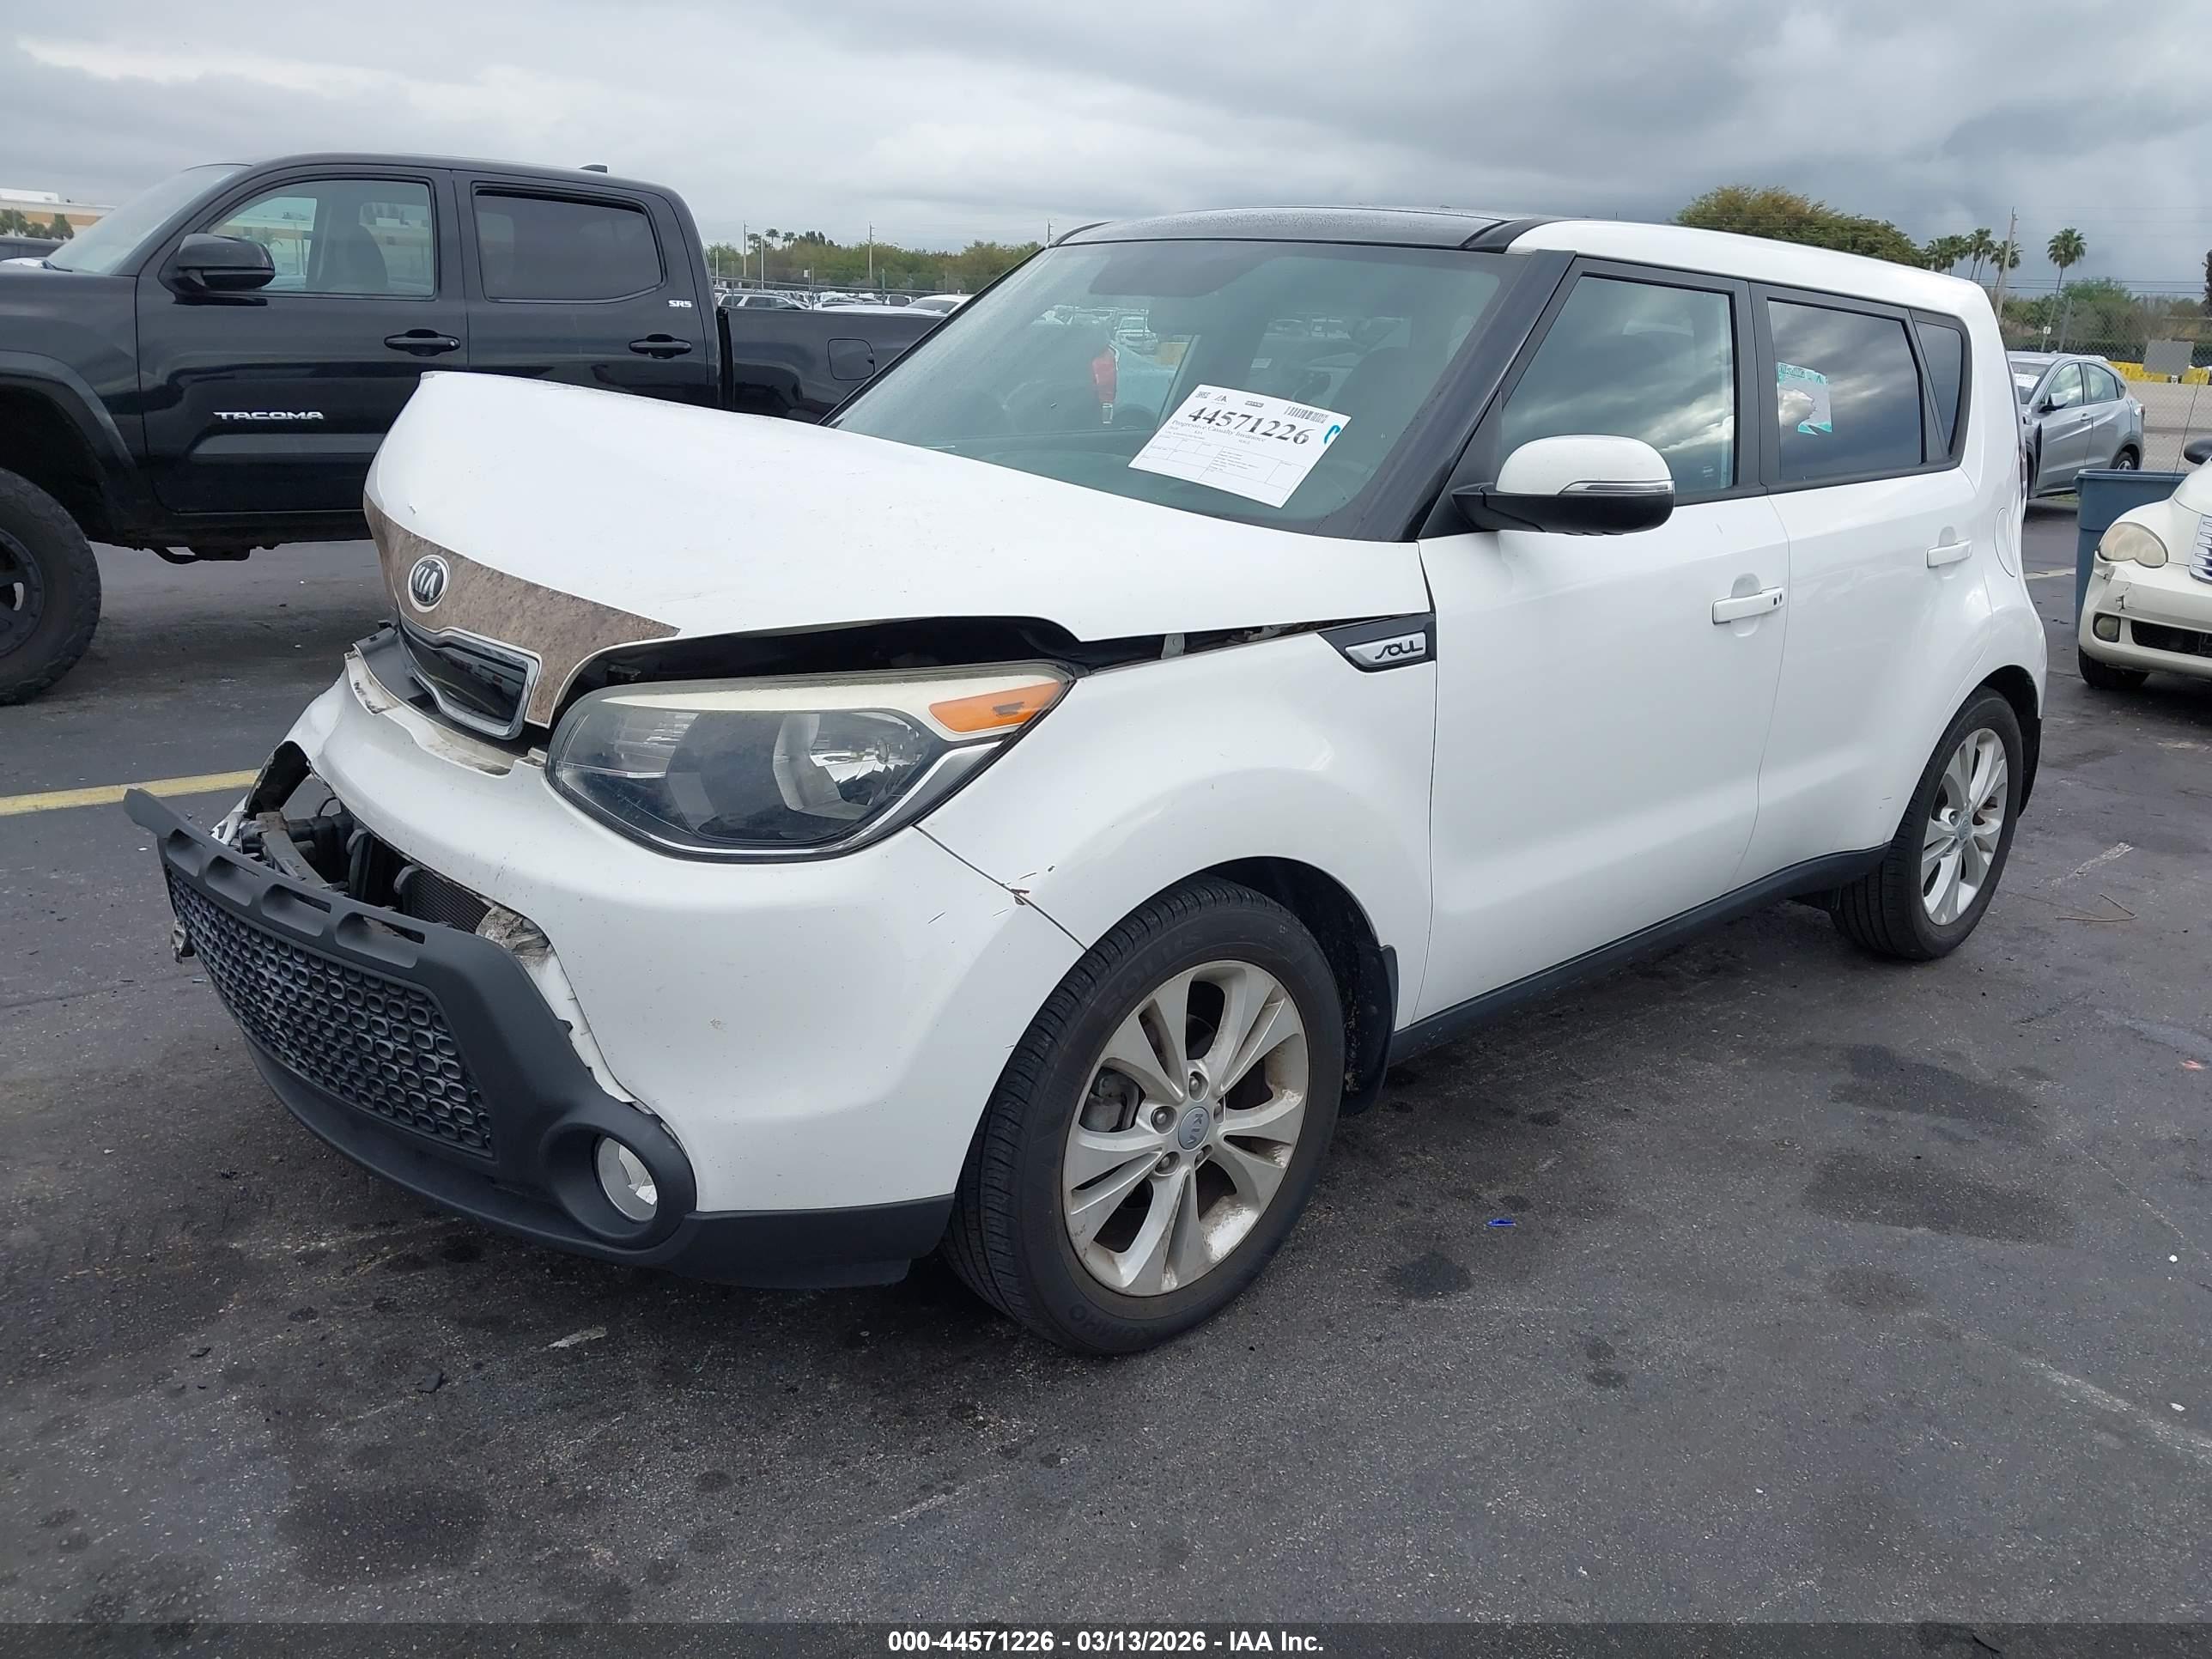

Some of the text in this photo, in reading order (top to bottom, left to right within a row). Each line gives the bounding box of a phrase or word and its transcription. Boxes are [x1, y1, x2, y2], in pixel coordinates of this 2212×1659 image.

[213, 411, 324, 420] TACOMA
[1188, 406, 1316, 446] 44571226
[1171, 419, 1207, 431] Progressive
[1207, 425, 1234, 436] Casualty
[1236, 431, 1267, 443] Insurance
[1375, 640, 1424, 660] SOUL
[1187, 1112, 1204, 1145] KIA
